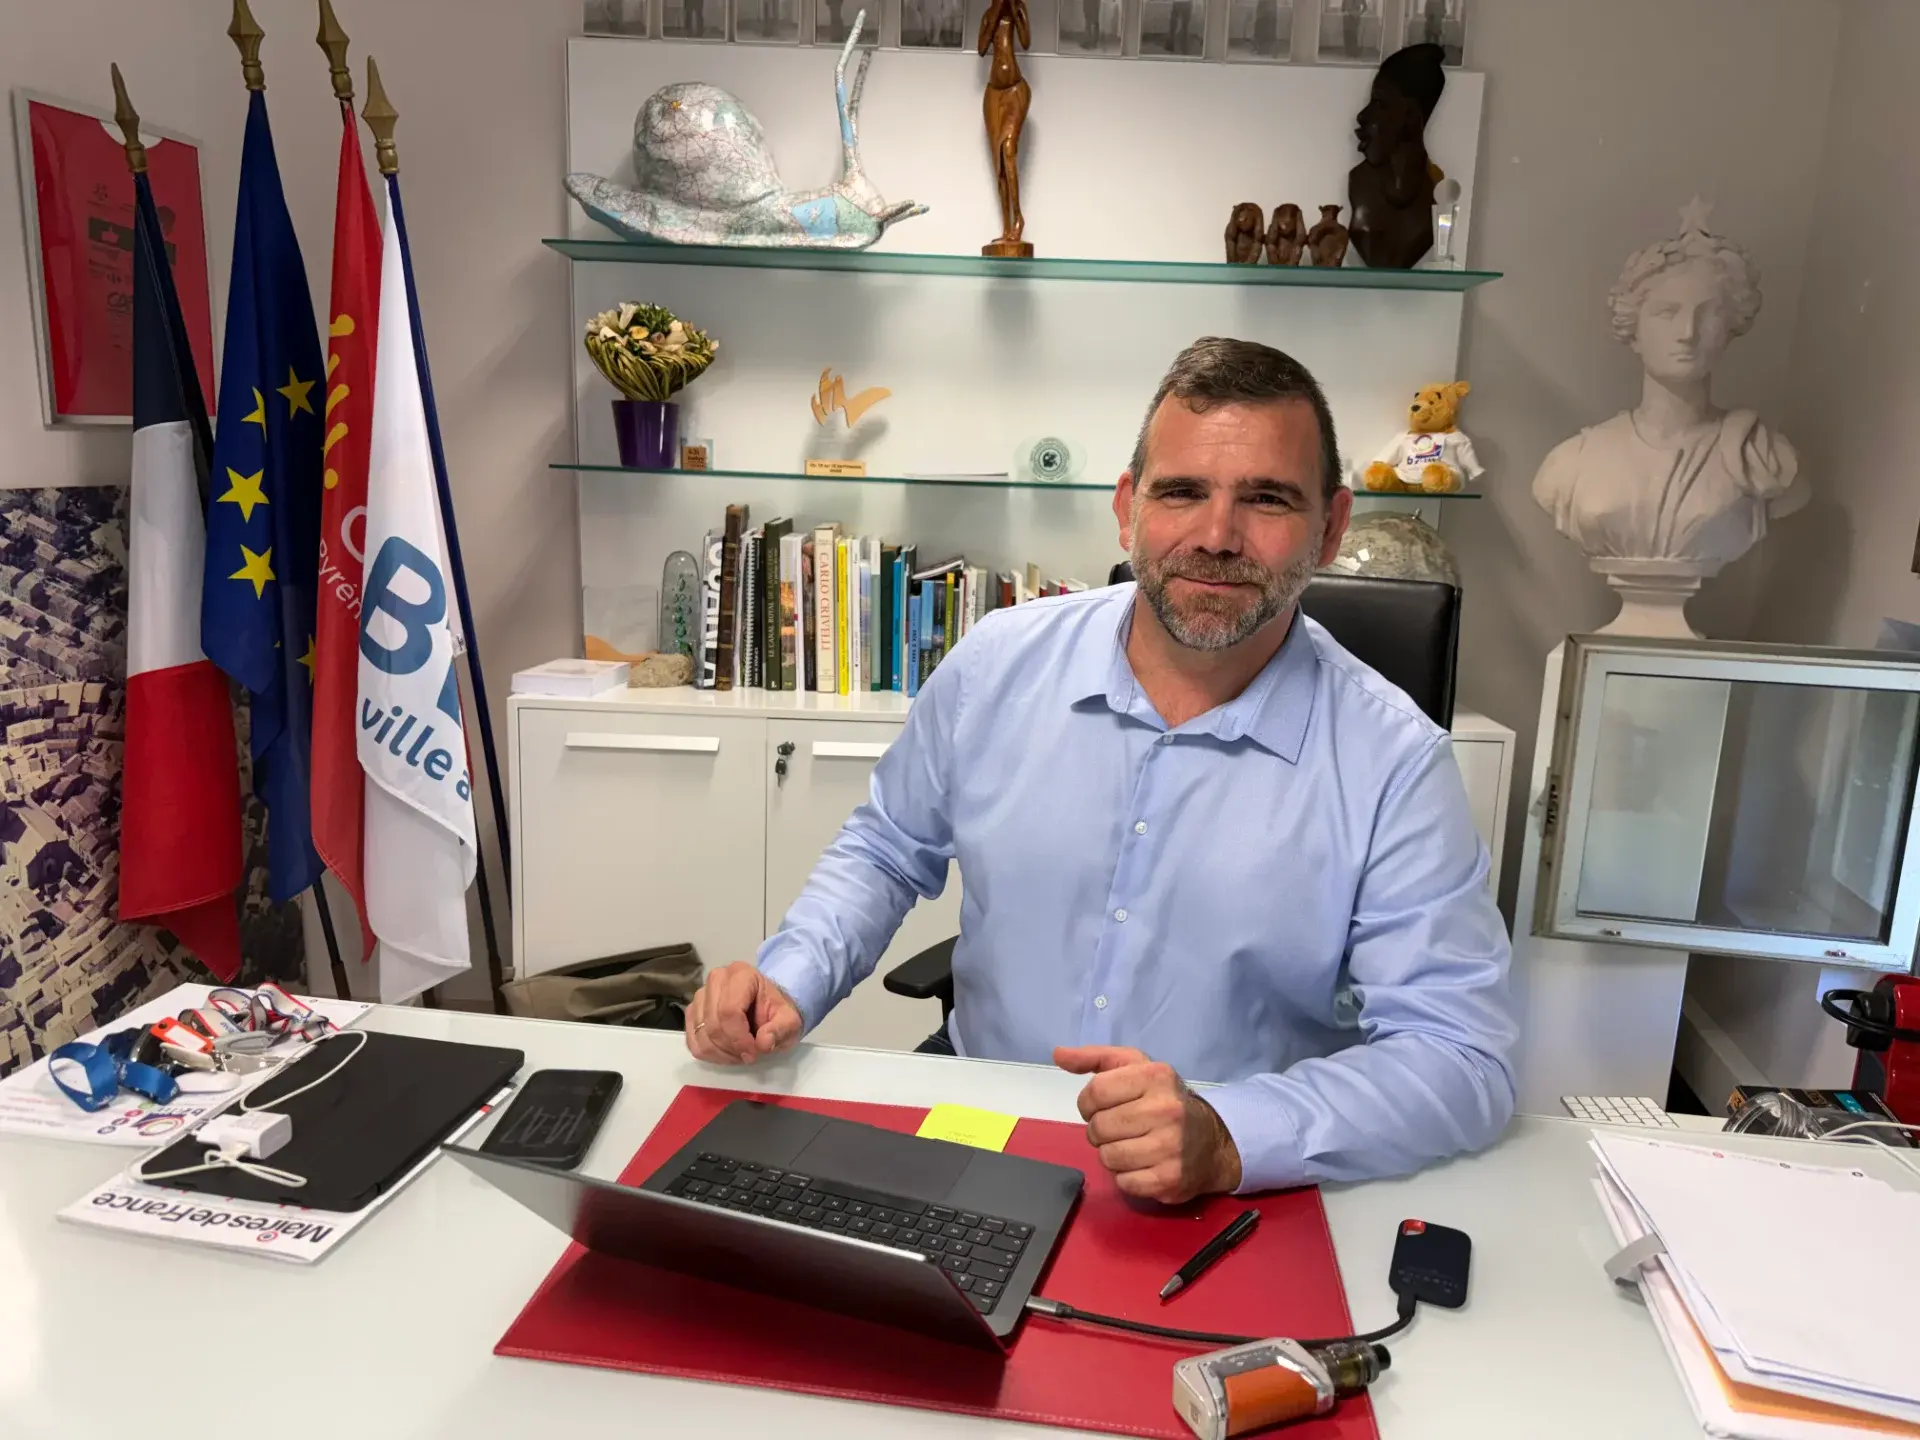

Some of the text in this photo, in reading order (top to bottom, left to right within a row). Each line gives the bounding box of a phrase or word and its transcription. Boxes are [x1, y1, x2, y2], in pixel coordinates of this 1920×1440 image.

[820, 552, 831, 651] CARLO CRIVELLI
[362, 698, 453, 781] ville
